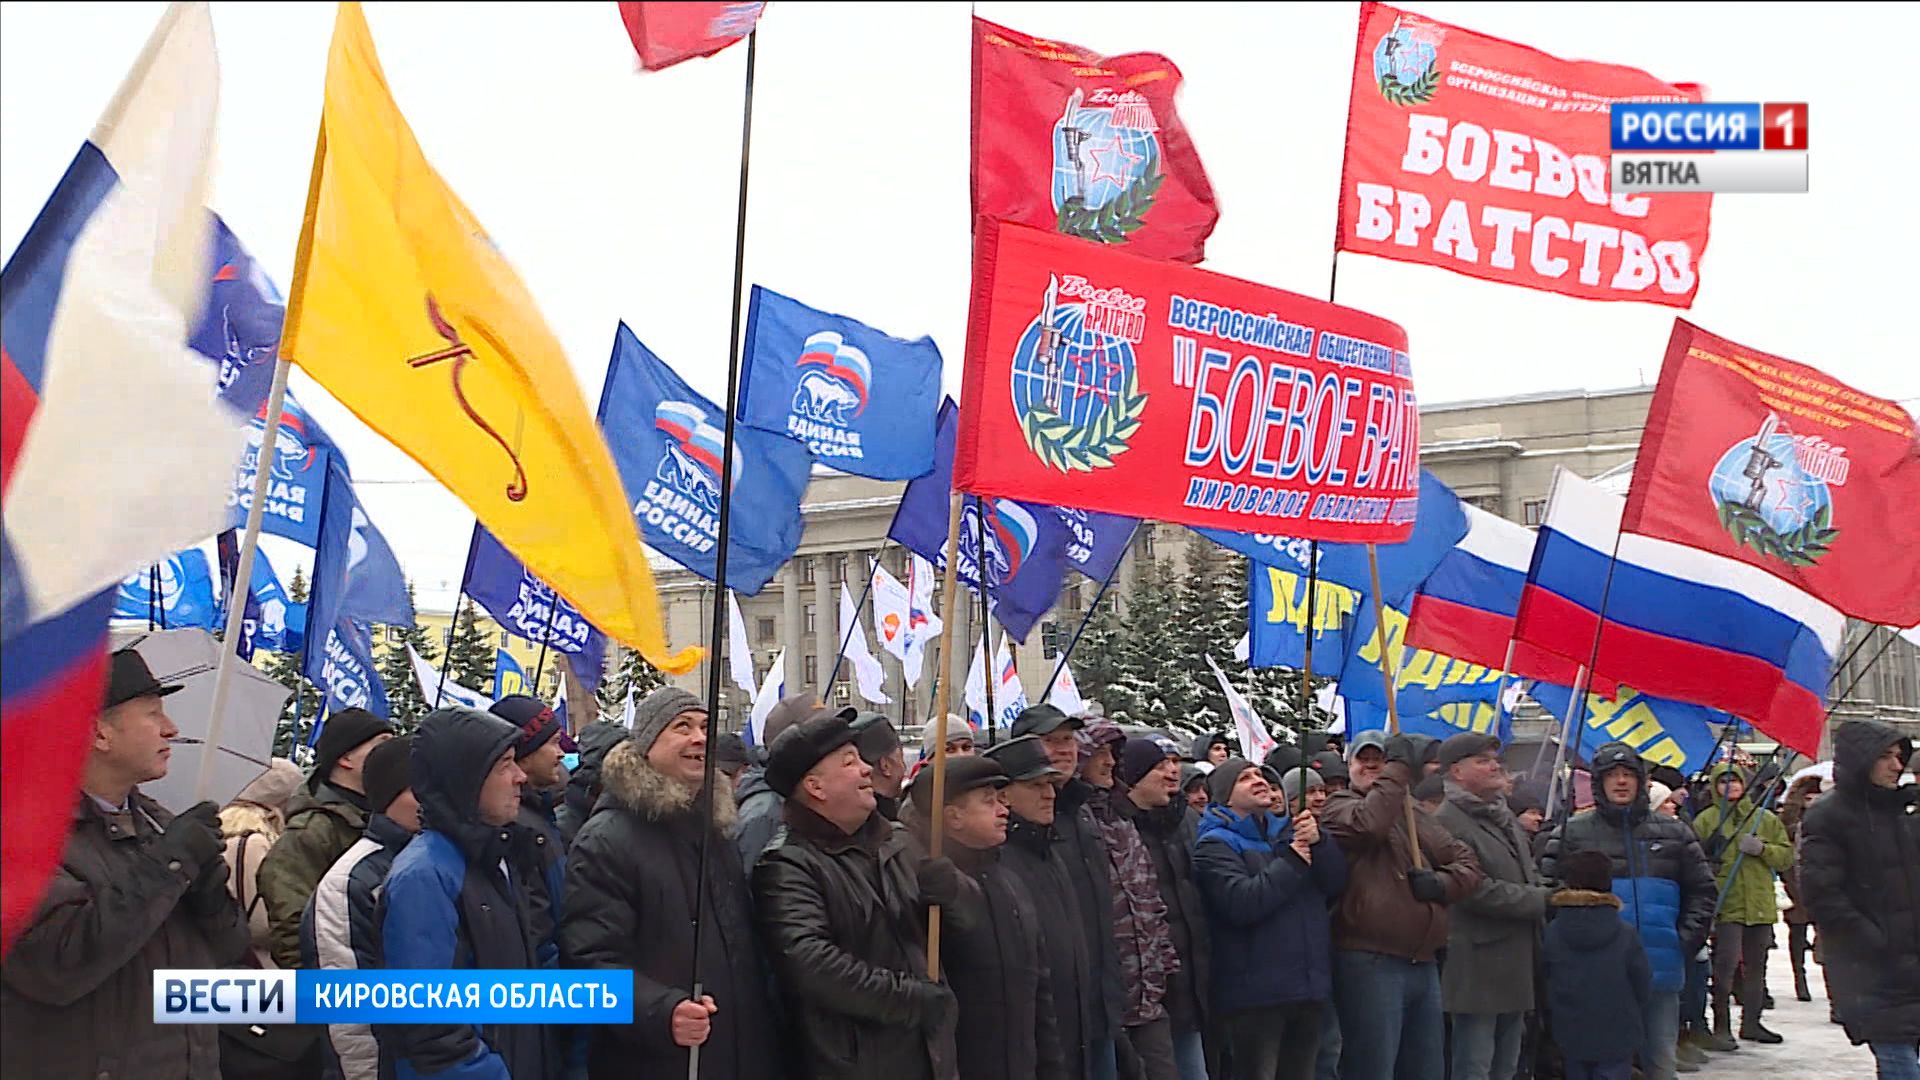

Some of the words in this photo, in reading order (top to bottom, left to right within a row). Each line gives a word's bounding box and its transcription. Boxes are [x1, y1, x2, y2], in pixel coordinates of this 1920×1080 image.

[1356, 183, 1695, 294] БРАТСТВО
[1059, 274, 1147, 310] Боевое
[1083, 301, 1147, 345] БРАТСТВО
[1169, 295, 1315, 358] ВСЕРОССИЙСКАЯ
[787, 415, 862, 447] ЕДИНАЯ
[1173, 335, 1362, 488] "БОЕВОЕ
[1184, 477, 1309, 519] КИРОВСКОЕ
[634, 499, 715, 553] РОССИЯ
